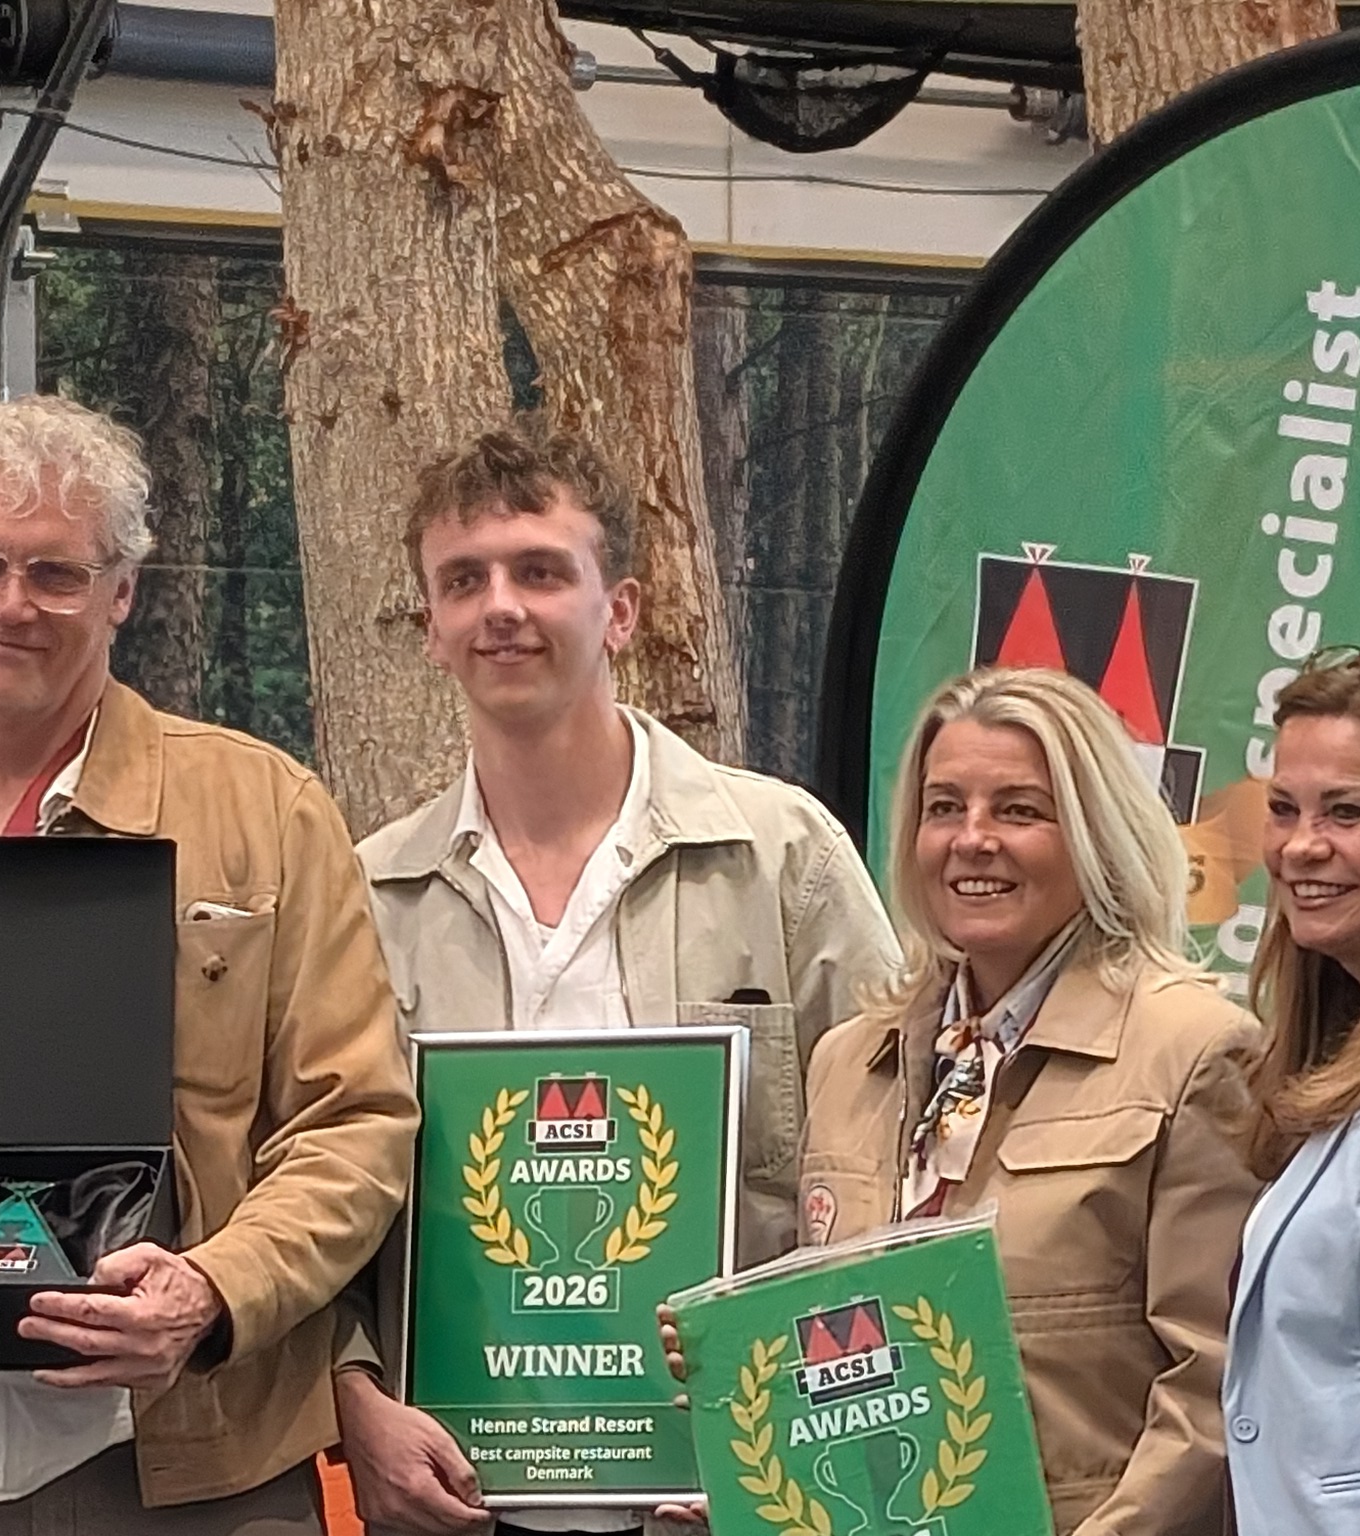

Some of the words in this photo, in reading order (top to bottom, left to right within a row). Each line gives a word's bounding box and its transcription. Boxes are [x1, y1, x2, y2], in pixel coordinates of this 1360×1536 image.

[544, 1119, 594, 1140] ACSI
[510, 1157, 632, 1183] AWARDS
[522, 1274, 608, 1306] 2026
[484, 1343, 645, 1377] WINNER
[817, 1352, 876, 1387] ACSI
[470, 1417, 528, 1433] Henne
[531, 1416, 590, 1433] Strand
[594, 1416, 654, 1432] Resort
[788, 1385, 931, 1447] AWARDS
[470, 1447, 501, 1460] Best
[505, 1446, 571, 1464] campsite
[573, 1446, 652, 1460] restaurant
[526, 1465, 593, 1480] Denmark
